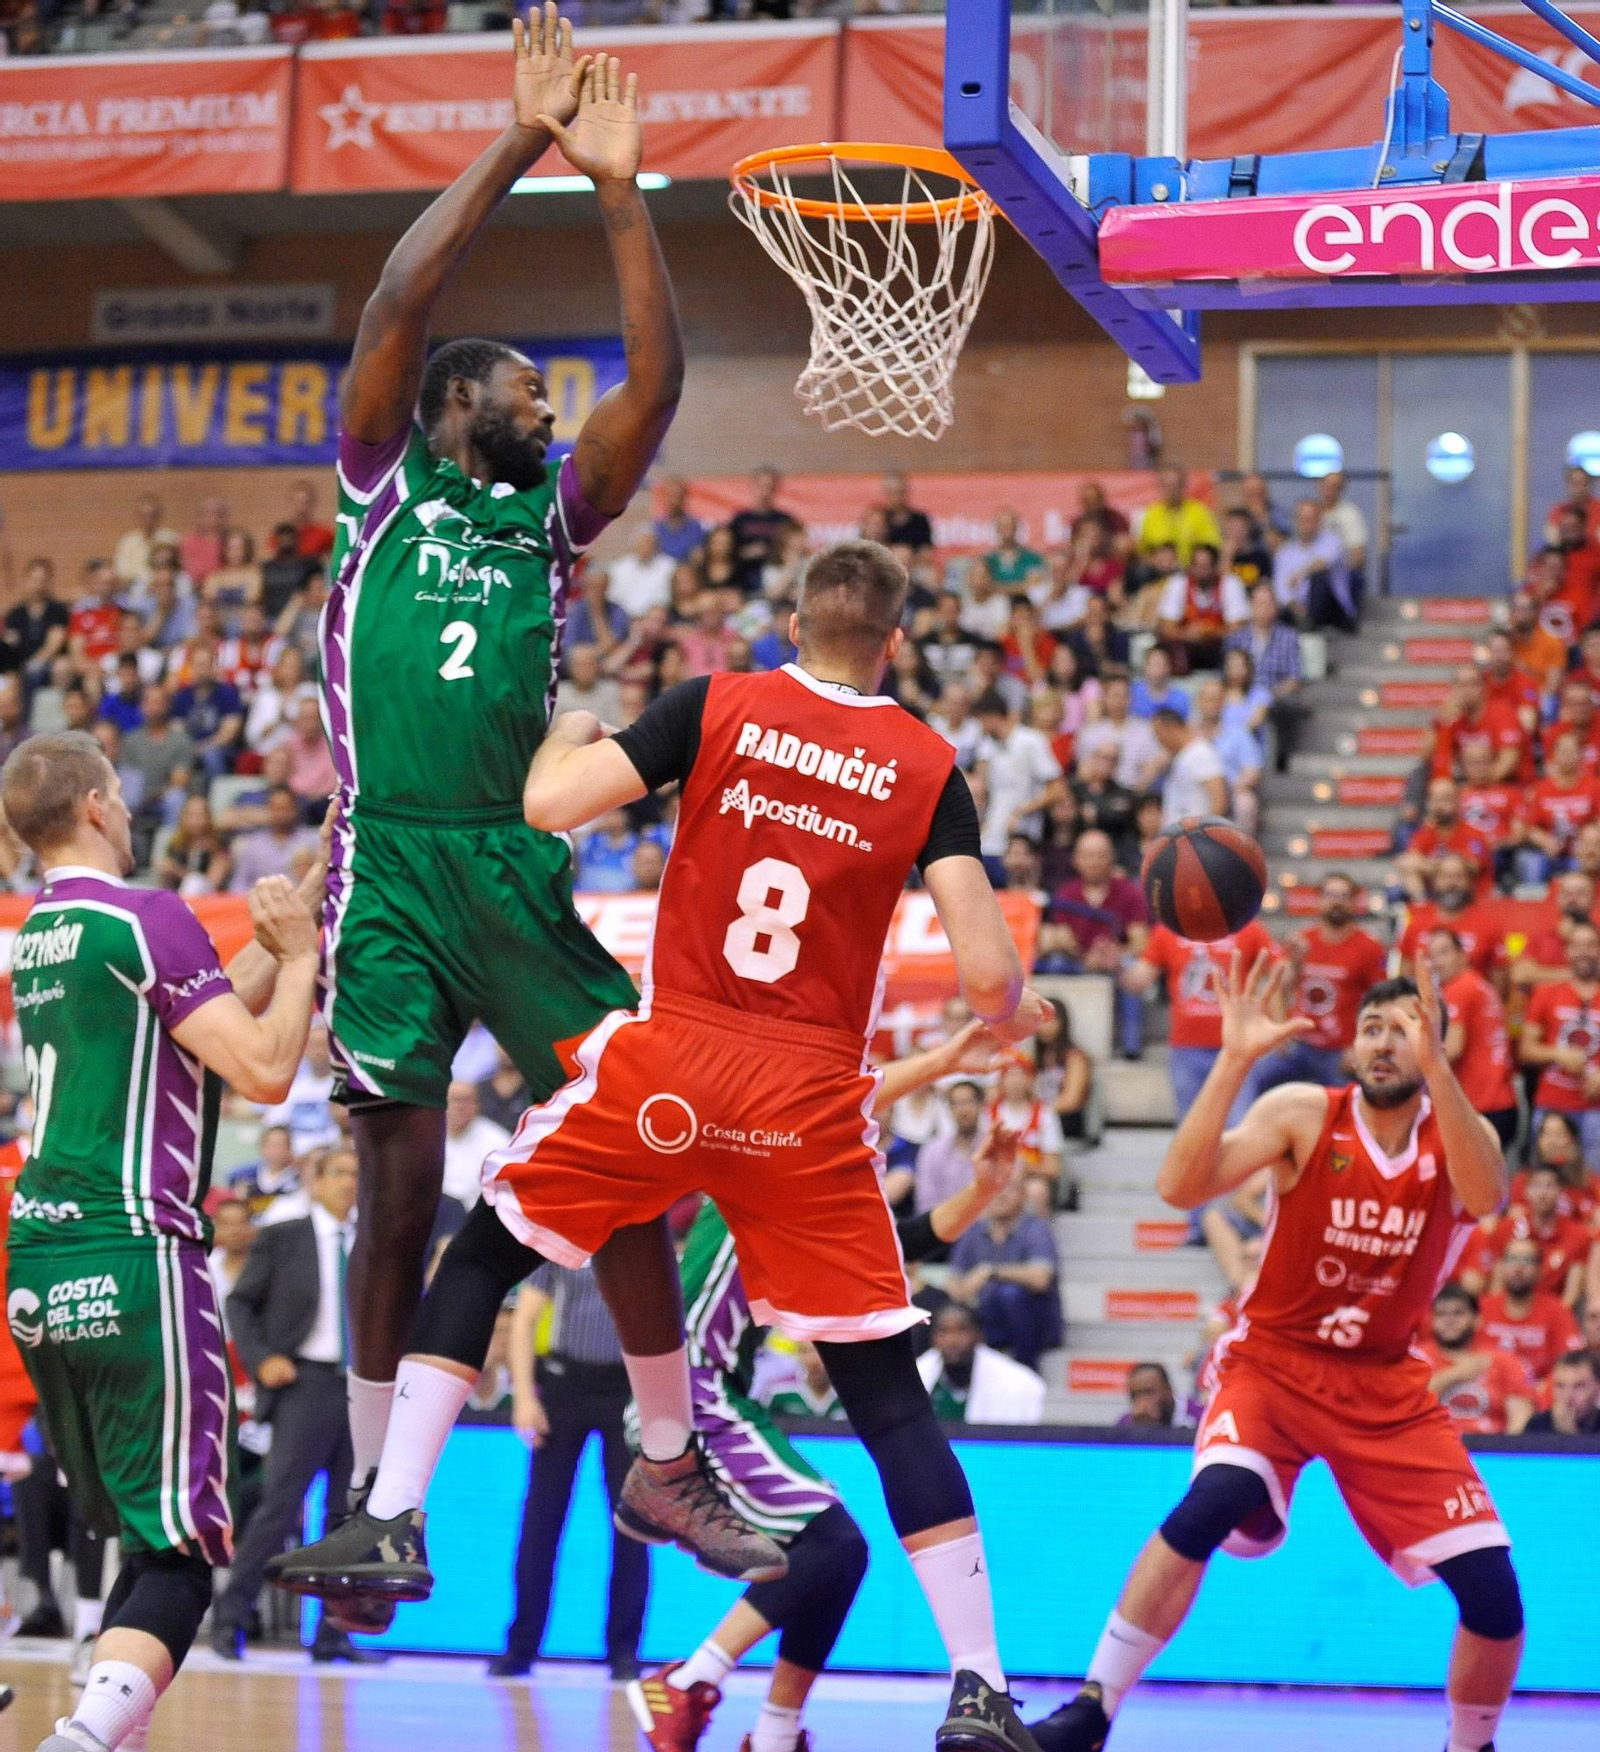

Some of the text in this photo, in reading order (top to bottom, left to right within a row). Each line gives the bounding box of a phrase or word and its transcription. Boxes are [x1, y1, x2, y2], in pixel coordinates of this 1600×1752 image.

[97, 89, 279, 133] PREMIUM
[384, 102, 513, 133] ESTRE
[1293, 182, 1600, 274] ende
[438, 620, 478, 681] 2
[735, 722, 898, 801] RADONČIĆ
[723, 857, 811, 984] 8
[702, 1123, 747, 1143] Costa
[47, 1273, 119, 1306] COSTA
[46, 1299, 121, 1328] DEL SOL
